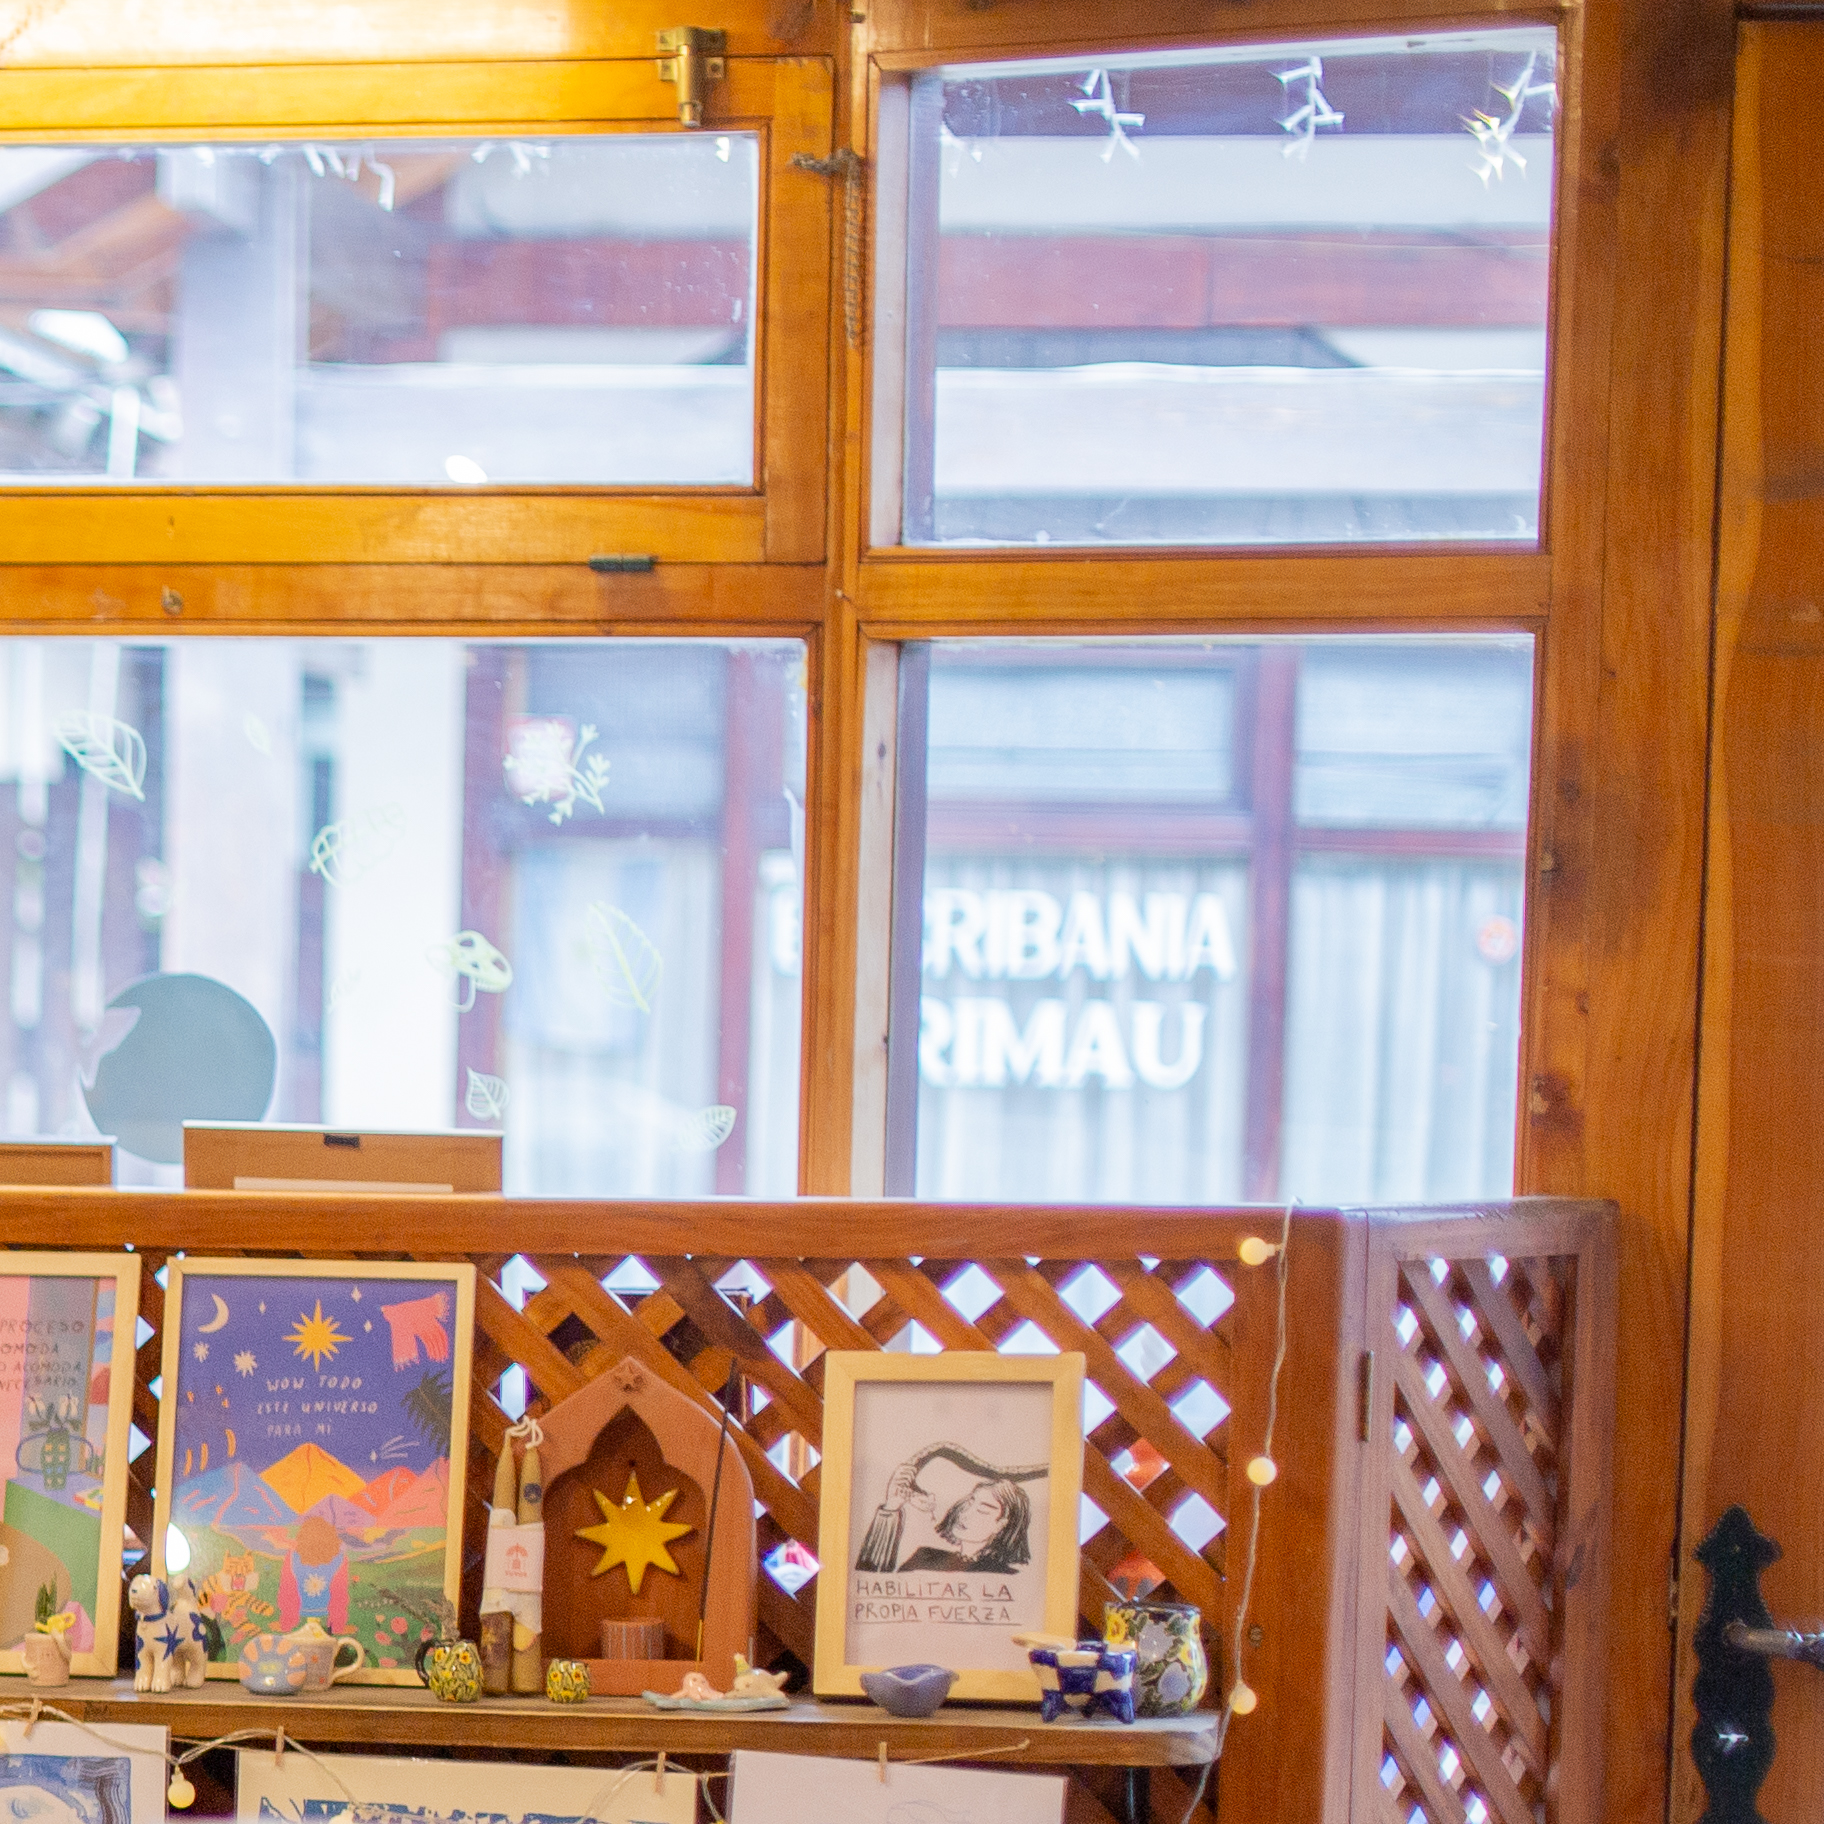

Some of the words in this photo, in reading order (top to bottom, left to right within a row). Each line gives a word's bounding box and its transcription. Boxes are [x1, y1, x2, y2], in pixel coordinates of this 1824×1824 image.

[918, 996, 1206, 1090] RIMAU
[0, 1318, 85, 1335] PROCESO
[266, 1377, 304, 1392] WOW
[319, 1375, 362, 1390] TODO
[301, 1400, 378, 1414] UNIVERSO
[267, 1423, 302, 1437] PARA
[856, 1579, 972, 1600] HABILITAR
[982, 1584, 1013, 1600] LA
[854, 1603, 918, 1620] PROPIA
[928, 1605, 1012, 1622] FUERZA
